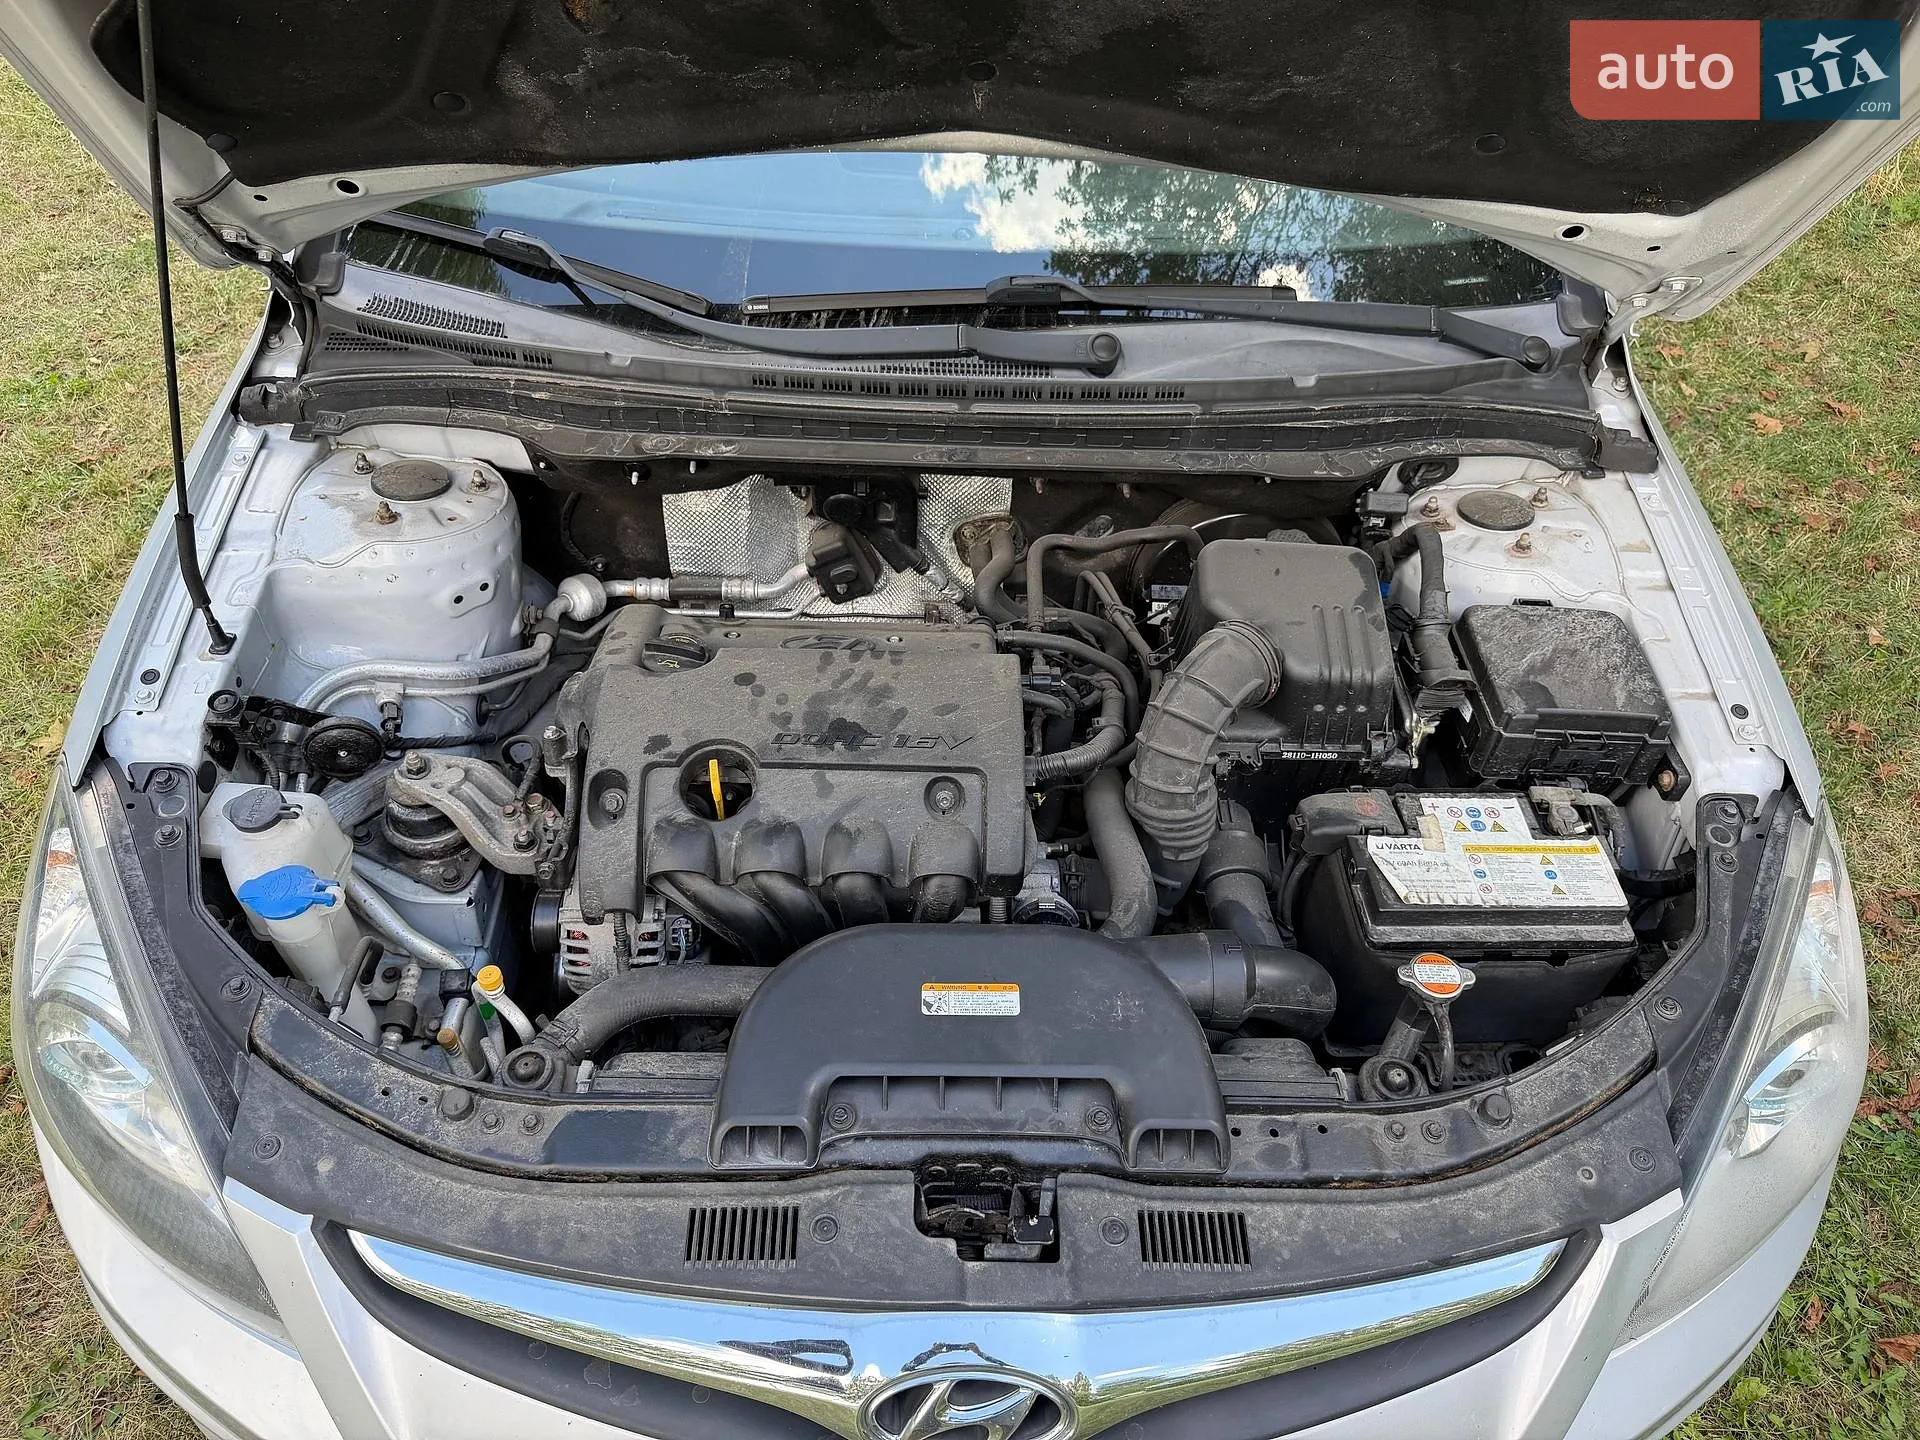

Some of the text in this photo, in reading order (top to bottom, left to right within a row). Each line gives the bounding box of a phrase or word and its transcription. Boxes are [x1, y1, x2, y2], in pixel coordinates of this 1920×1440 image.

[770, 732, 882, 748] DOHC
[1281, 751, 1338, 760] 28110-1H050
[1385, 843, 1422, 851] VARTA
